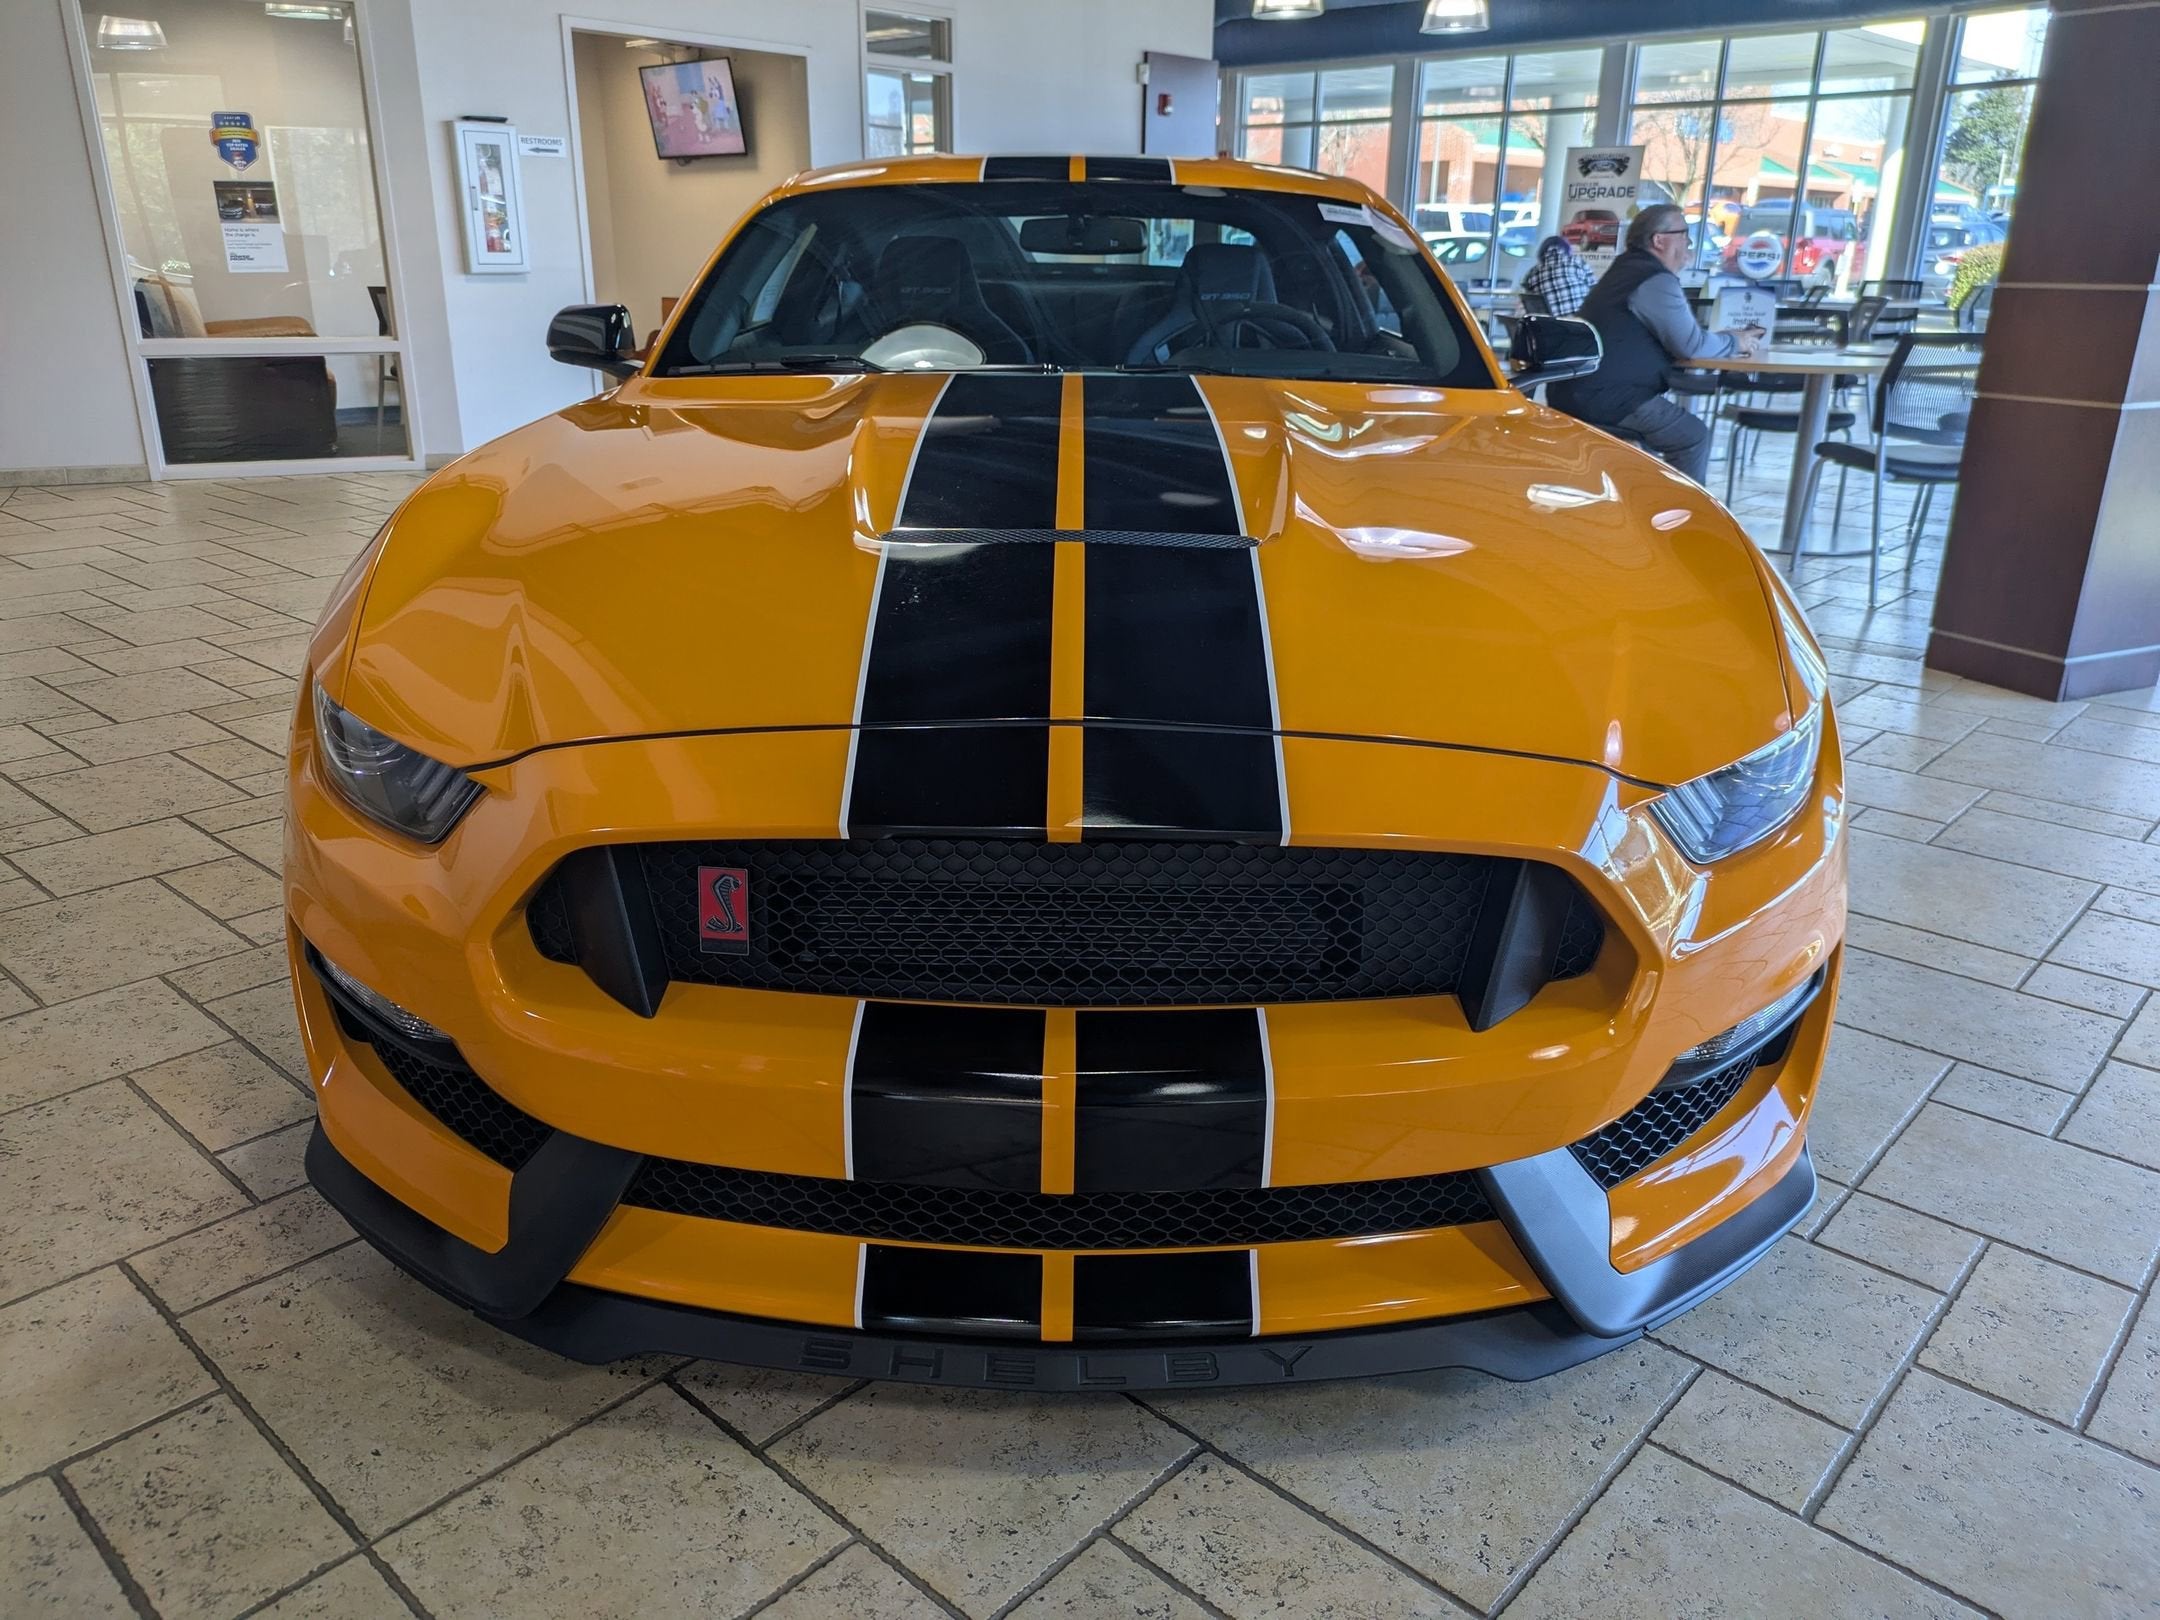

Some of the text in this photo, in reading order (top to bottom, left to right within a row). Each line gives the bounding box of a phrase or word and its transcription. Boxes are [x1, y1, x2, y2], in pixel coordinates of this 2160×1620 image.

[520, 136, 562, 145] RESTROOMS
[1568, 185, 1636, 198] UPGRADE
[1738, 251, 1781, 261] PEPSI
[803, 1338, 1313, 1386] SHELBY
